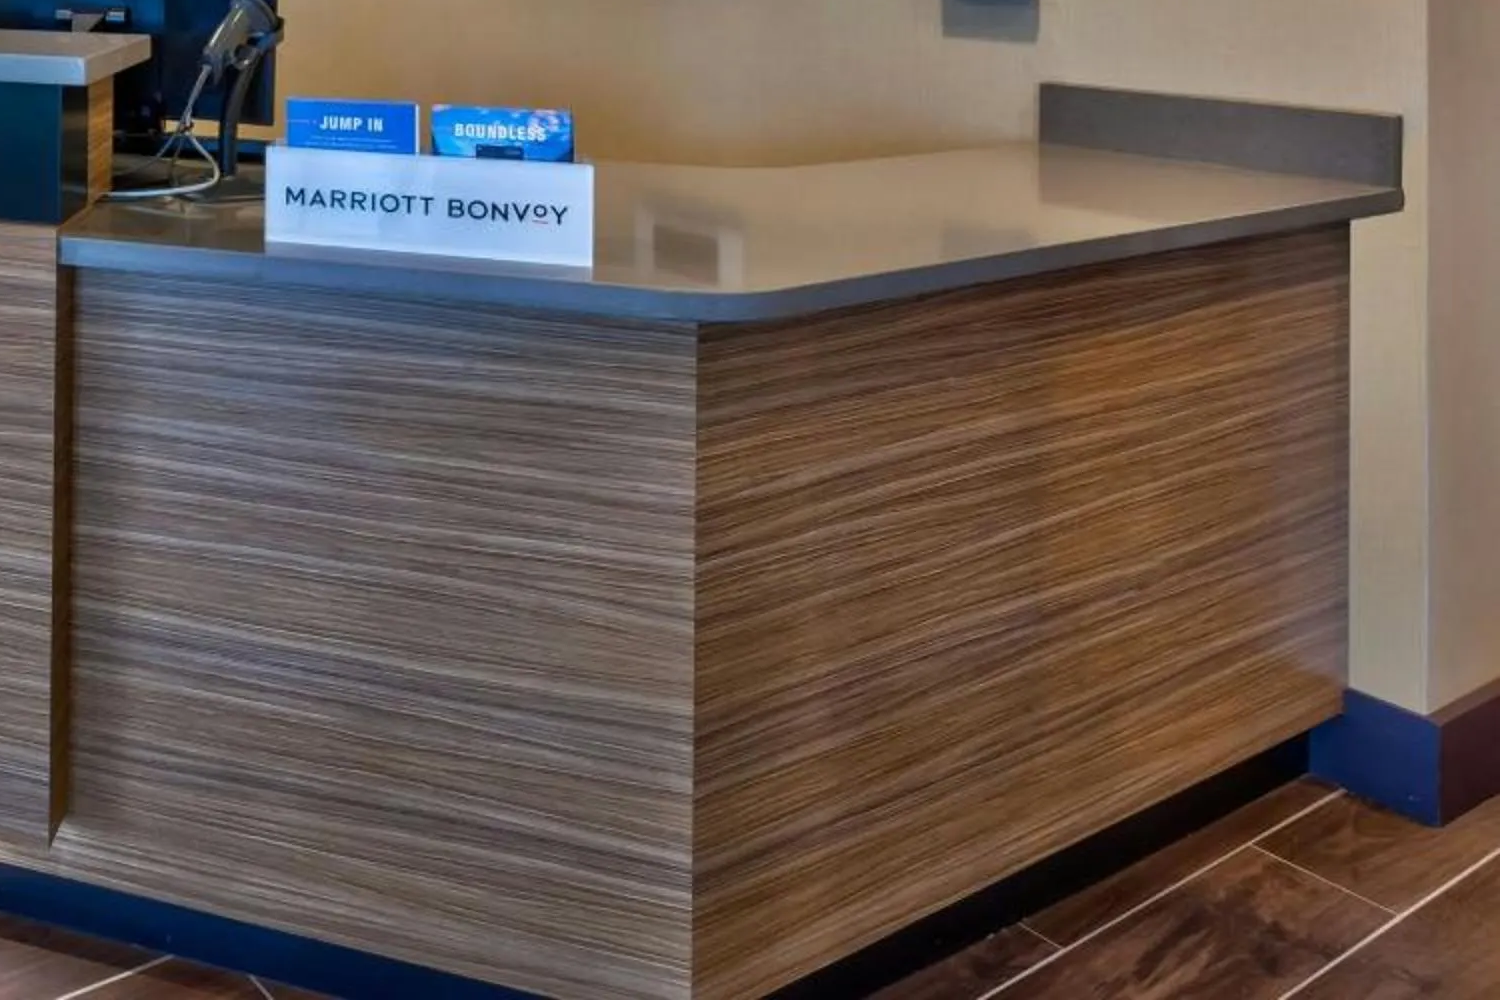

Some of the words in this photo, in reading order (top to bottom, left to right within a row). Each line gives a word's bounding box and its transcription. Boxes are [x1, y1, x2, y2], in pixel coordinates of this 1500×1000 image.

[320, 115, 362, 131] JUMP
[367, 117, 383, 132] IN
[455, 122, 546, 142] BOUNDLESS
[285, 186, 434, 217] MARRIOTT
